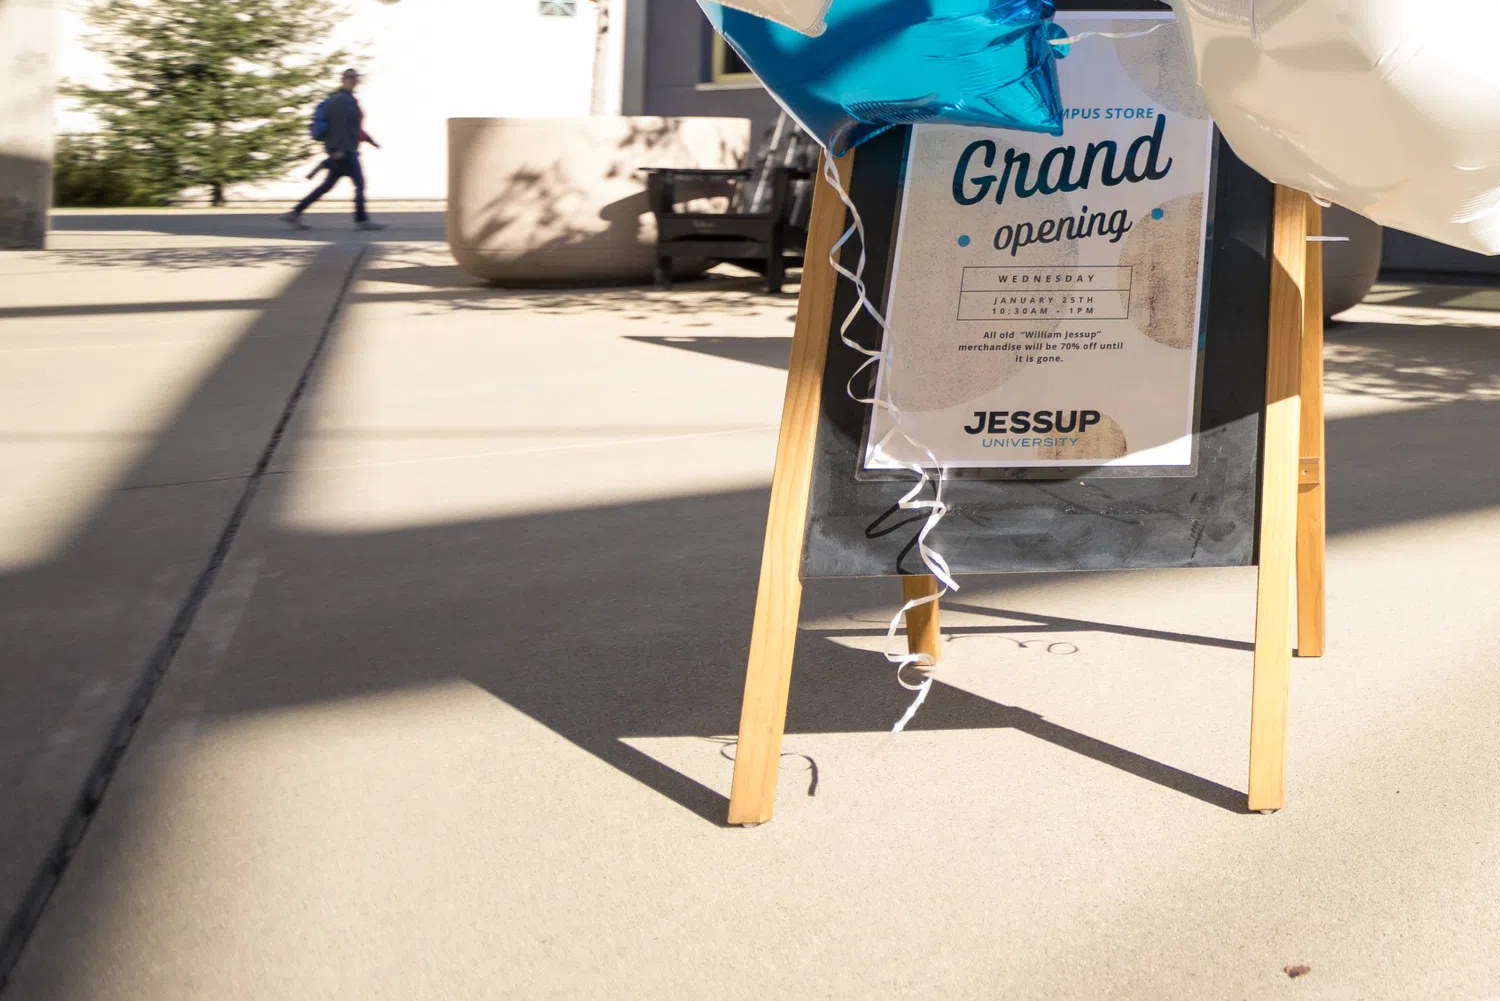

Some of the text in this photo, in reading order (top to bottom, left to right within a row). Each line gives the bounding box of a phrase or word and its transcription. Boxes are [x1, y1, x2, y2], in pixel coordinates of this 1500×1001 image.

[1062, 107, 1154, 119] MPUS STORE
[953, 113, 1172, 205] Grand
[993, 206, 1132, 256] opening
[999, 275, 1095, 283] WEDNESDAY
[993, 297, 1053, 305] JANUARY
[983, 331, 996, 339] All
[1000, 331, 1014, 339] old
[958, 343, 1021, 351] merchandise
[1046, 342, 1057, 350] be
[1060, 342, 1080, 350] 70%
[1083, 342, 1097, 350] off
[1100, 342, 1123, 350] until
[1016, 355, 1022, 363] it
[1037, 356, 1063, 364] gone.
[964, 410, 1100, 434] JESSUP
[982, 438, 1079, 448] UNIVERSITY
